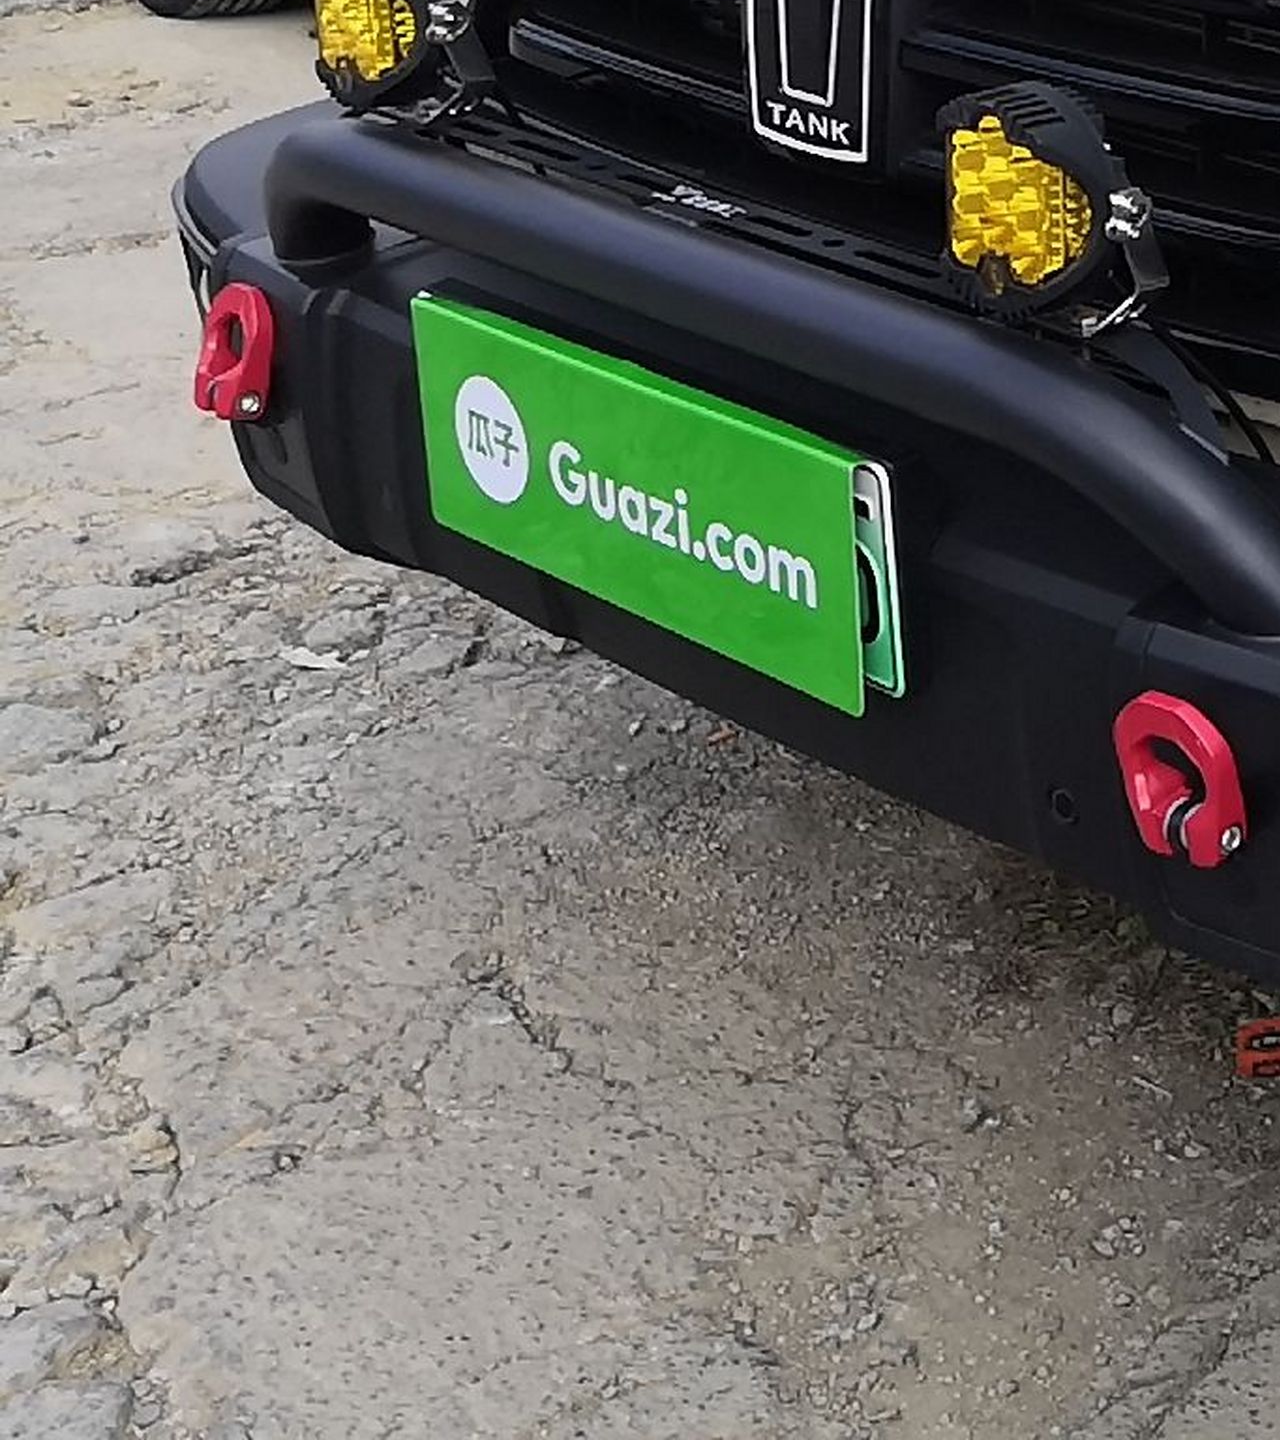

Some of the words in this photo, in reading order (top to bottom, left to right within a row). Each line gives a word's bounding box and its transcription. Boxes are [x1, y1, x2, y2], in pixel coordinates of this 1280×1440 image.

[765, 100, 850, 145] TANK
[467, 409, 520, 468] 瓜子
[548, 440, 819, 610] Guazi.com
